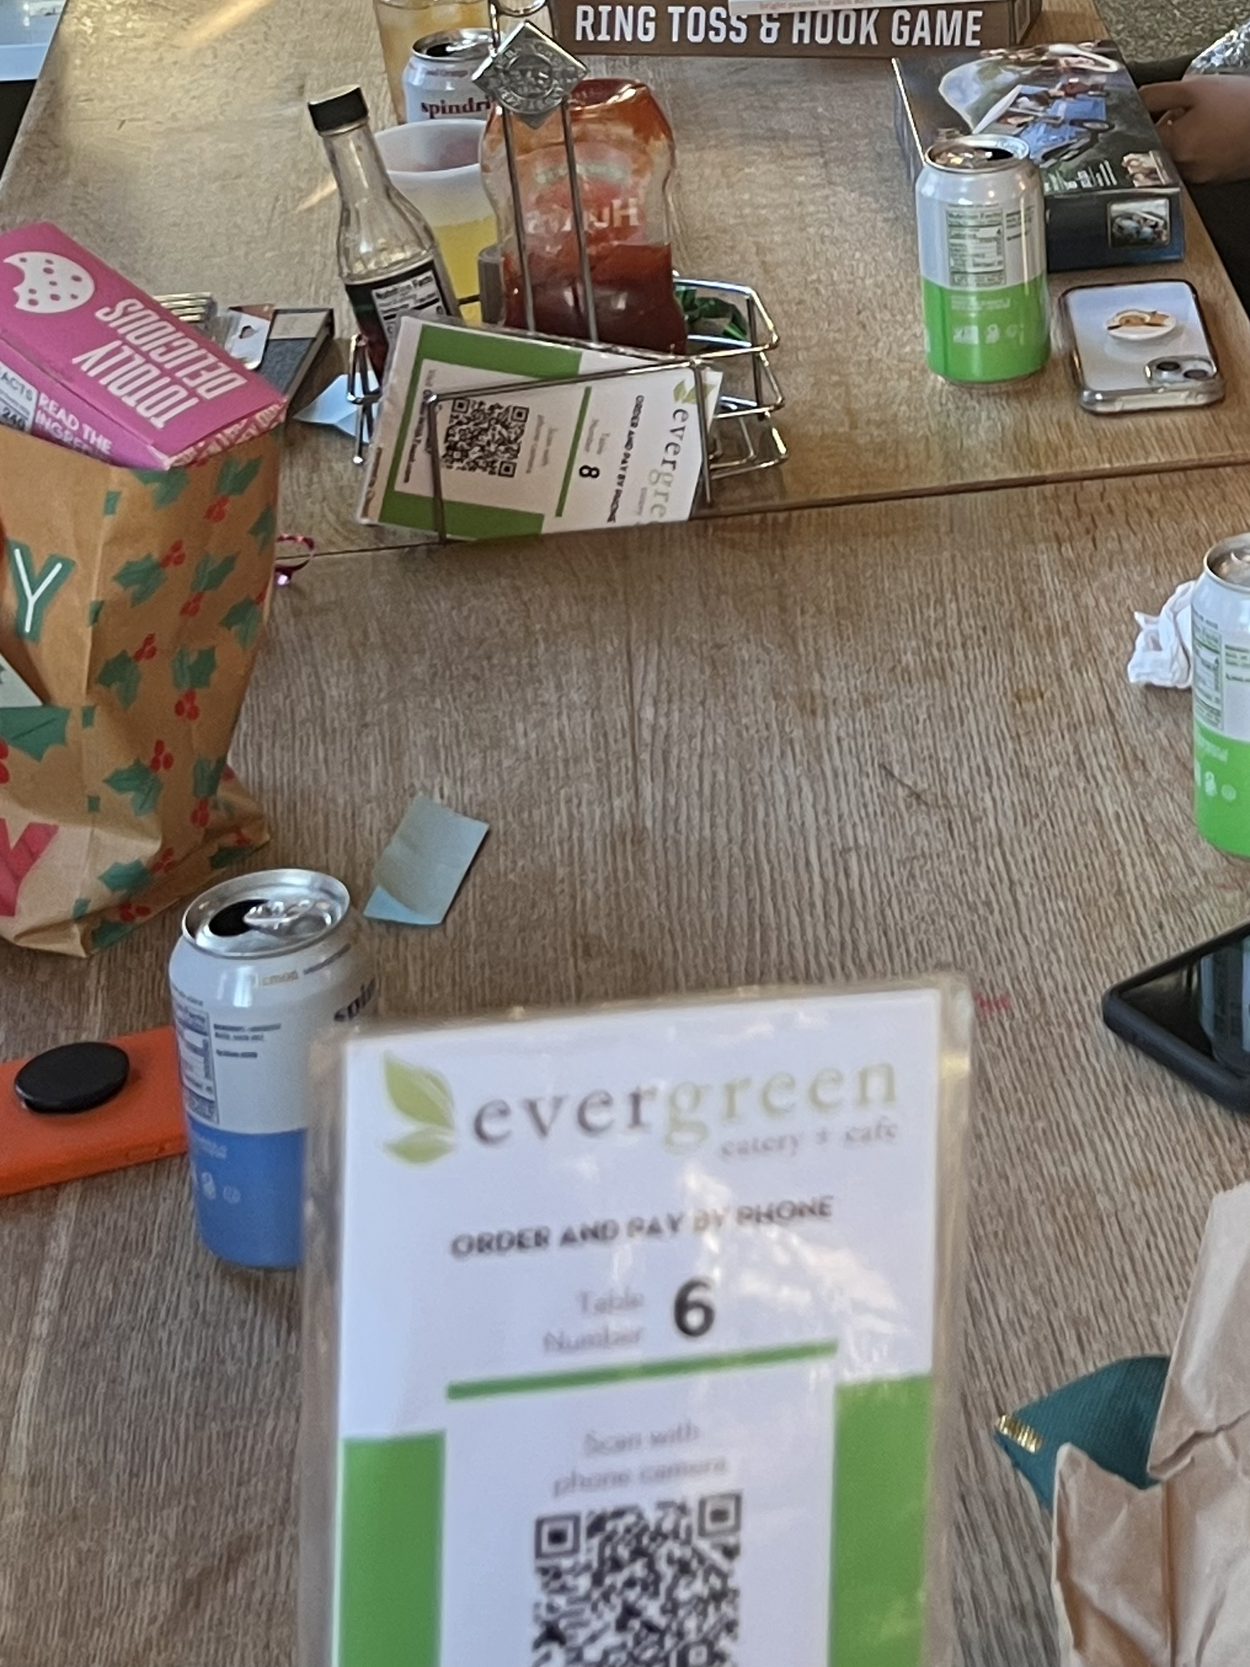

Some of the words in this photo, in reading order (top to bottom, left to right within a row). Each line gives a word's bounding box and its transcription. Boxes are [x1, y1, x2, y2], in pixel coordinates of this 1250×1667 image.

[575, 5, 656, 43] RING
[667, 6, 748, 43] TOSS
[759, 10, 781, 44] &
[792, 9, 880, 45] HOOK
[891, 9, 983, 47] GAME
[420, 96, 492, 120] spindri
[94, 298, 248, 400] DELICIOUS
[38, 391, 81, 431] READ
[82, 422, 113, 456] THE
[578, 465, 601, 479] 8
[648, 408, 690, 518] evergre
[473, 1060, 898, 1156] evergreen
[721, 1131, 799, 1158] eatery
[450, 1227, 549, 1259] ORDER
[558, 1219, 619, 1248] AND
[626, 1213, 685, 1238] PAY
[692, 1209, 731, 1232] BY
[736, 1195, 835, 1227] PHONE
[673, 1274, 716, 1338] 6
[542, 1325, 644, 1354] Number
[553, 1467, 632, 1498] phone
[639, 1457, 728, 1482] camera
